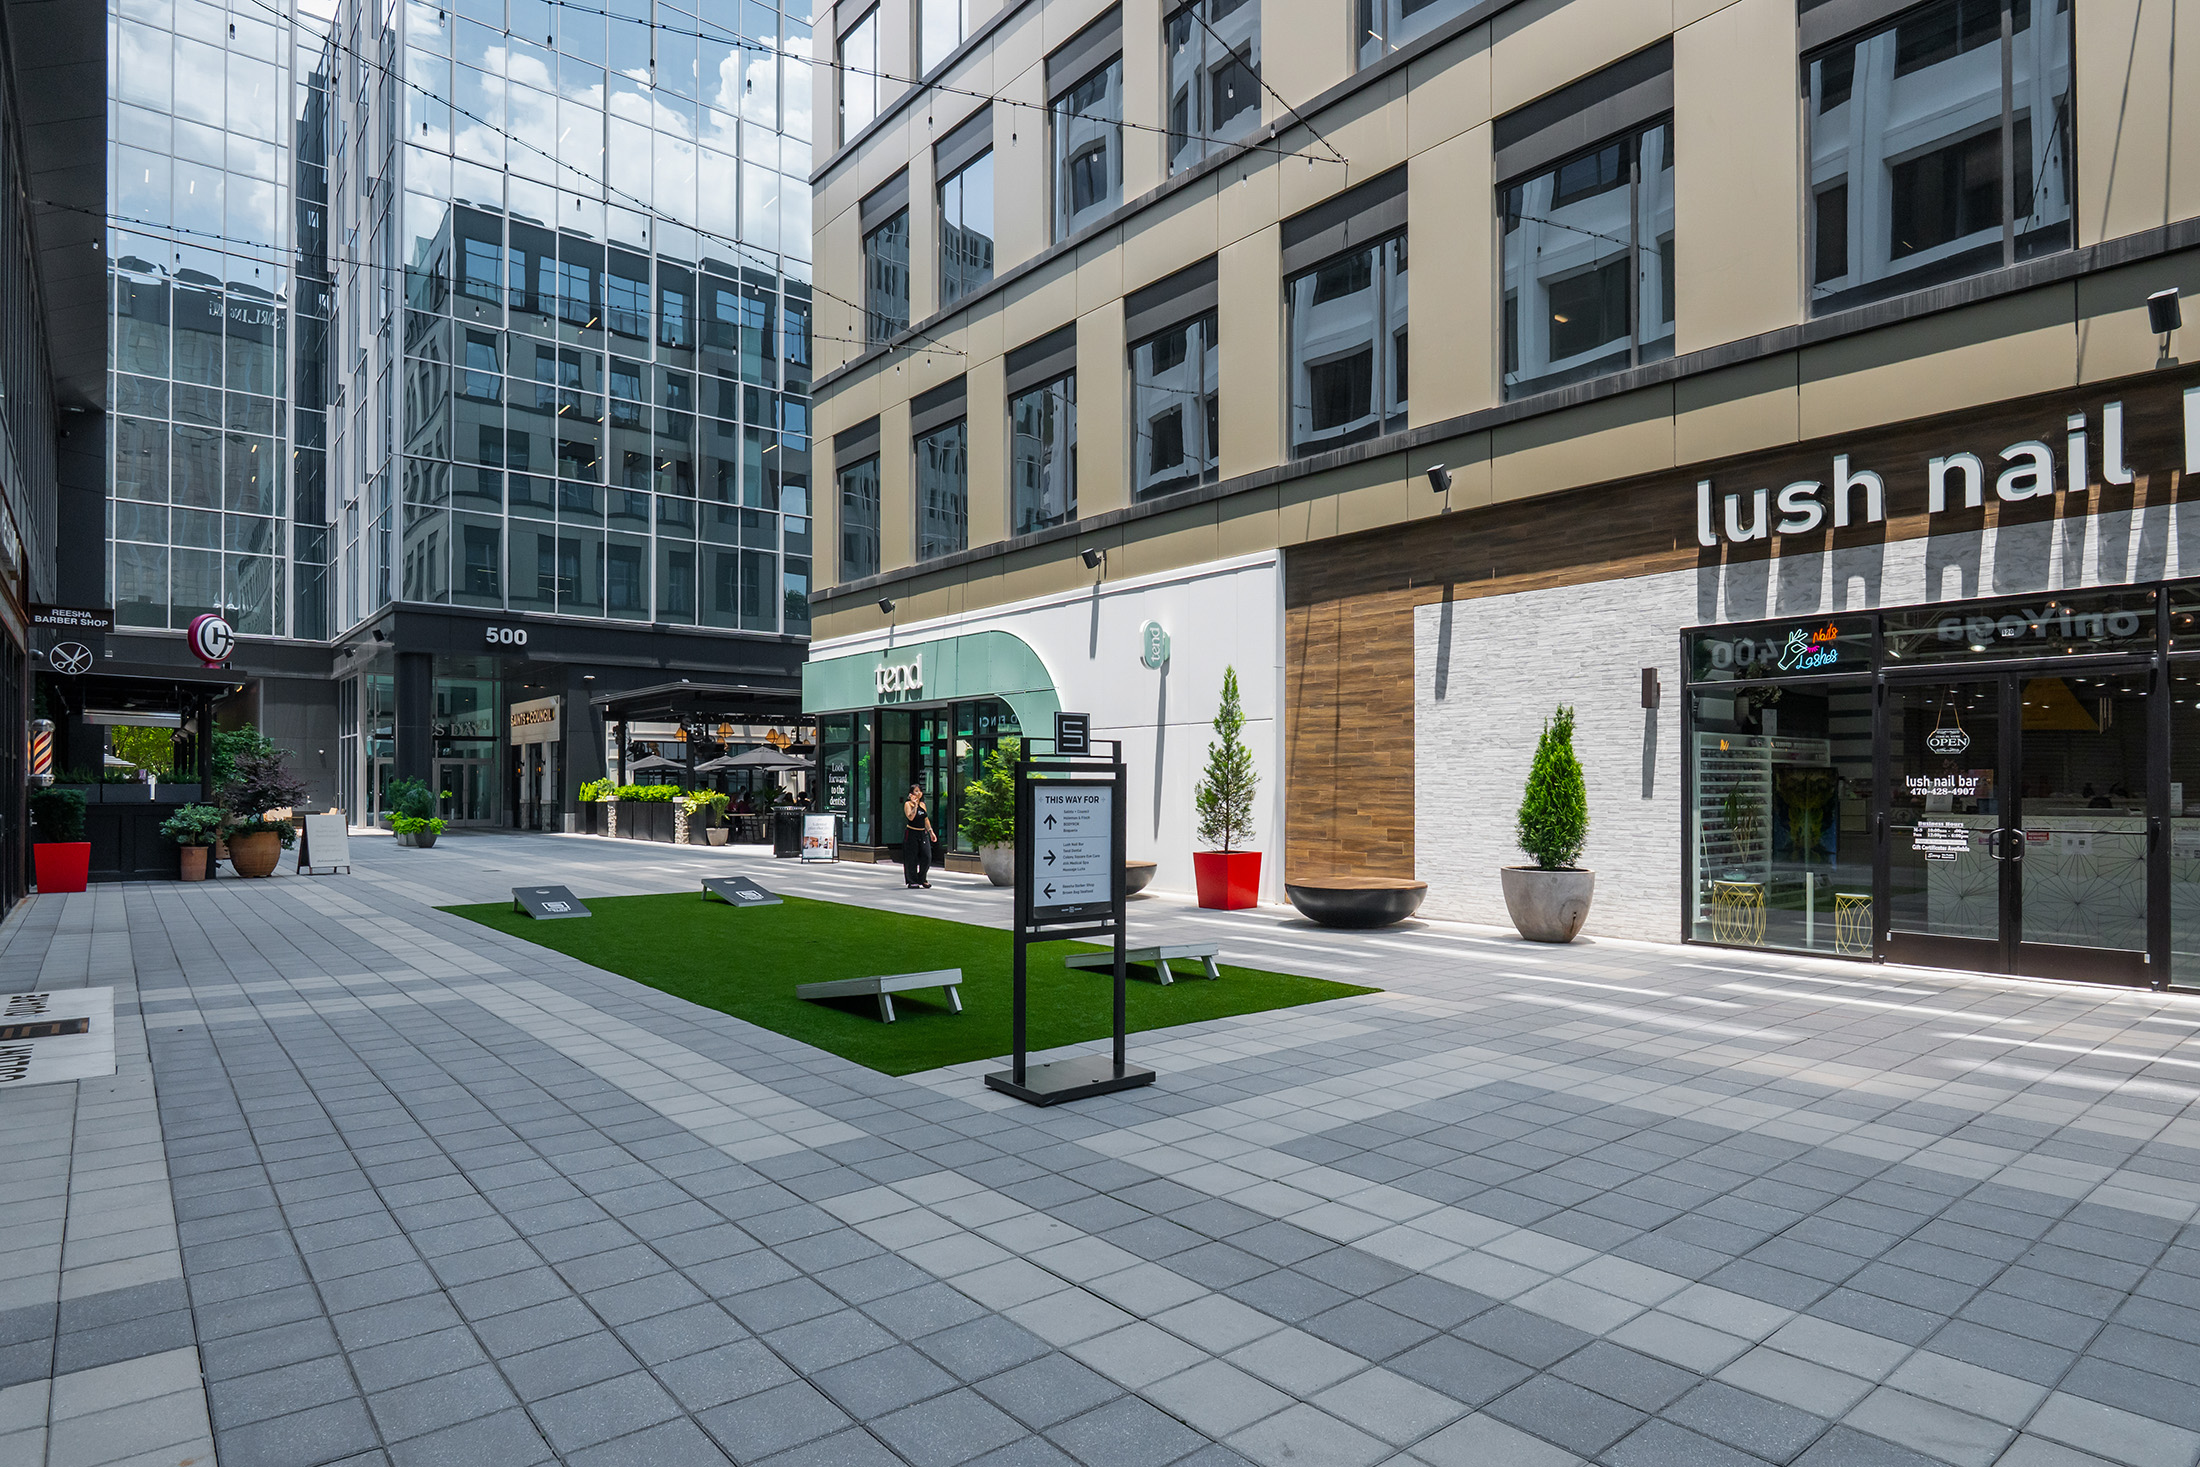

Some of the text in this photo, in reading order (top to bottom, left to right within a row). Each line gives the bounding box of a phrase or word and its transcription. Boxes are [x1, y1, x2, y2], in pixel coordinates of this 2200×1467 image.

[1697, 453, 1887, 547] lush
[1928, 400, 2135, 514] nail
[51, 609, 92, 618] REESHA
[34, 615, 109, 627] BARBER SHOP
[486, 626, 528, 646] 500
[1812, 623, 1839, 643] Nails
[1150, 627, 1161, 662] tend
[1796, 646, 1839, 669] Lashes
[874, 653, 923, 694] tend
[1929, 738, 1967, 747] OPEN
[831, 762, 845, 771] Look
[829, 773, 847, 783] forward
[1906, 775, 1979, 787] lush nail bar
[831, 785, 845, 794] to the
[1910, 787, 1975, 796] 470-428-4907
[829, 796, 846, 806] dentist
[1045, 795, 1100, 804] THIS WAY FOR
